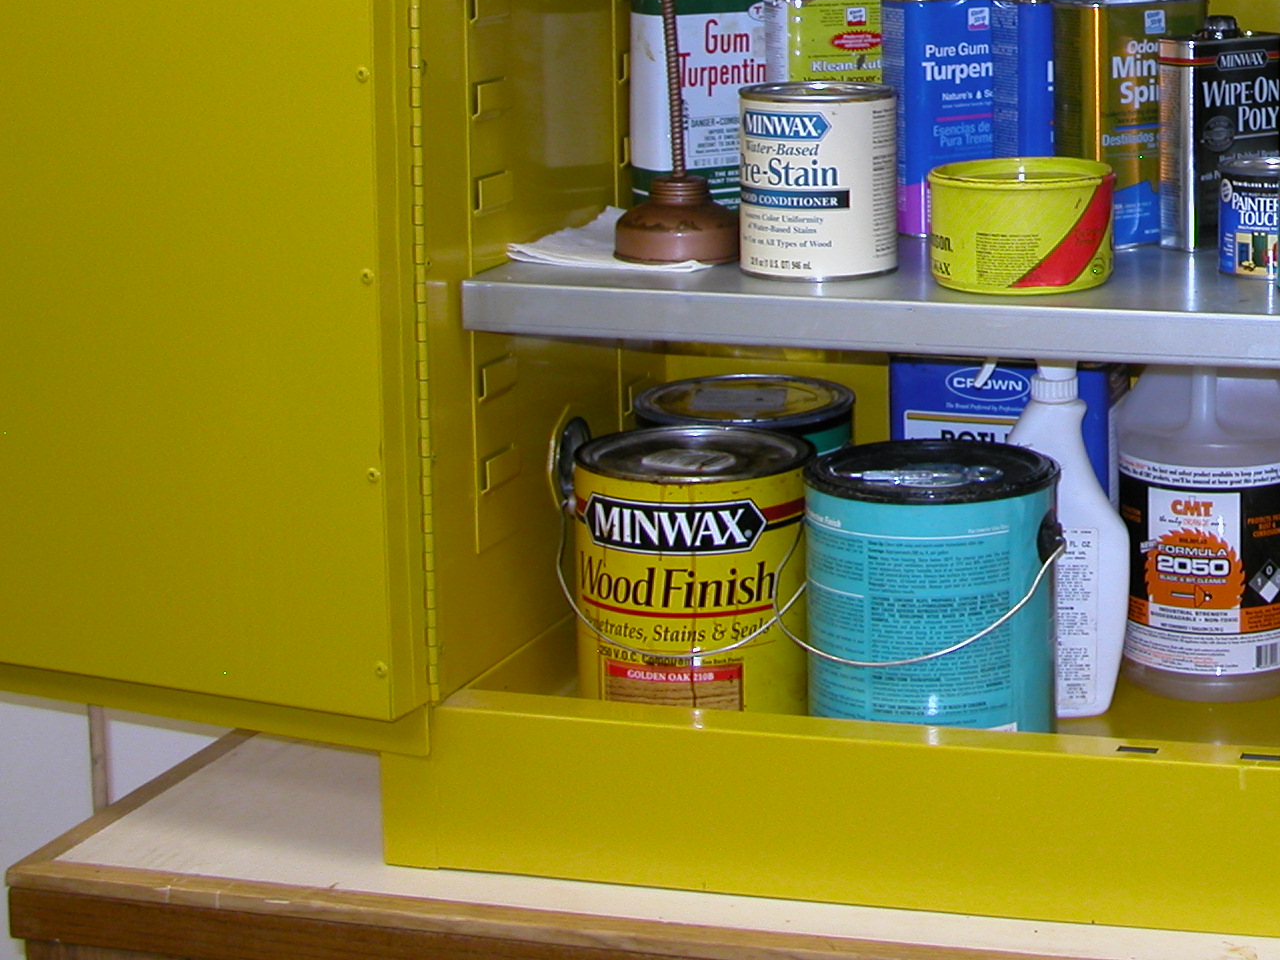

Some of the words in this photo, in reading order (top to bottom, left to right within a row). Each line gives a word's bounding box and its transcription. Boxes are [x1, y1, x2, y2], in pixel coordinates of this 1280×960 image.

[705, 18, 750, 54] Gum
[925, 43, 957, 58] Pure
[958, 42, 989, 57] Gum
[1220, 52, 1264, 68] MINWAX
[942, 90, 974, 101] Nature's
[1202, 76, 1280, 108] WIPE-ON
[746, 112, 819, 137] MINWAX
[1237, 105, 1280, 132] POLY
[933, 124, 976, 138] Esencias
[978, 122, 990, 133] de
[940, 135, 963, 147] Pura
[1102, 132, 1155, 147] Destilados
[746, 141, 820, 157] Water-Based
[759, 192, 839, 207] CONDITIONER
[762, 212, 779, 221] Color
[781, 213, 824, 225] Uniformity
[793, 225, 817, 234] Stains
[777, 240, 797, 249] Types
[809, 240, 832, 248] Wood
[953, 377, 1023, 391] CRWN
[1171, 499, 1213, 517] CMT
[594, 501, 746, 547] MINWAX
[1158, 544, 1227, 557] FORMULA
[1156, 555, 1230, 576] 2050
[580, 550, 653, 607] Wood
[661, 560, 775, 608] Finish
[1160, 574, 1178, 582] BLADE
[1197, 577, 1226, 585] CLEANER
[1150, 611, 1196, 622] BIODEGRADABLE
[1159, 607, 1194, 616] INDUSTRIAL
[652, 624, 705, 642] Stains
[711, 623, 727, 639] &
[614, 649, 640, 663] V.O.C.
[627, 669, 668, 681] GOLDEN
[670, 671, 692, 682] OAK
